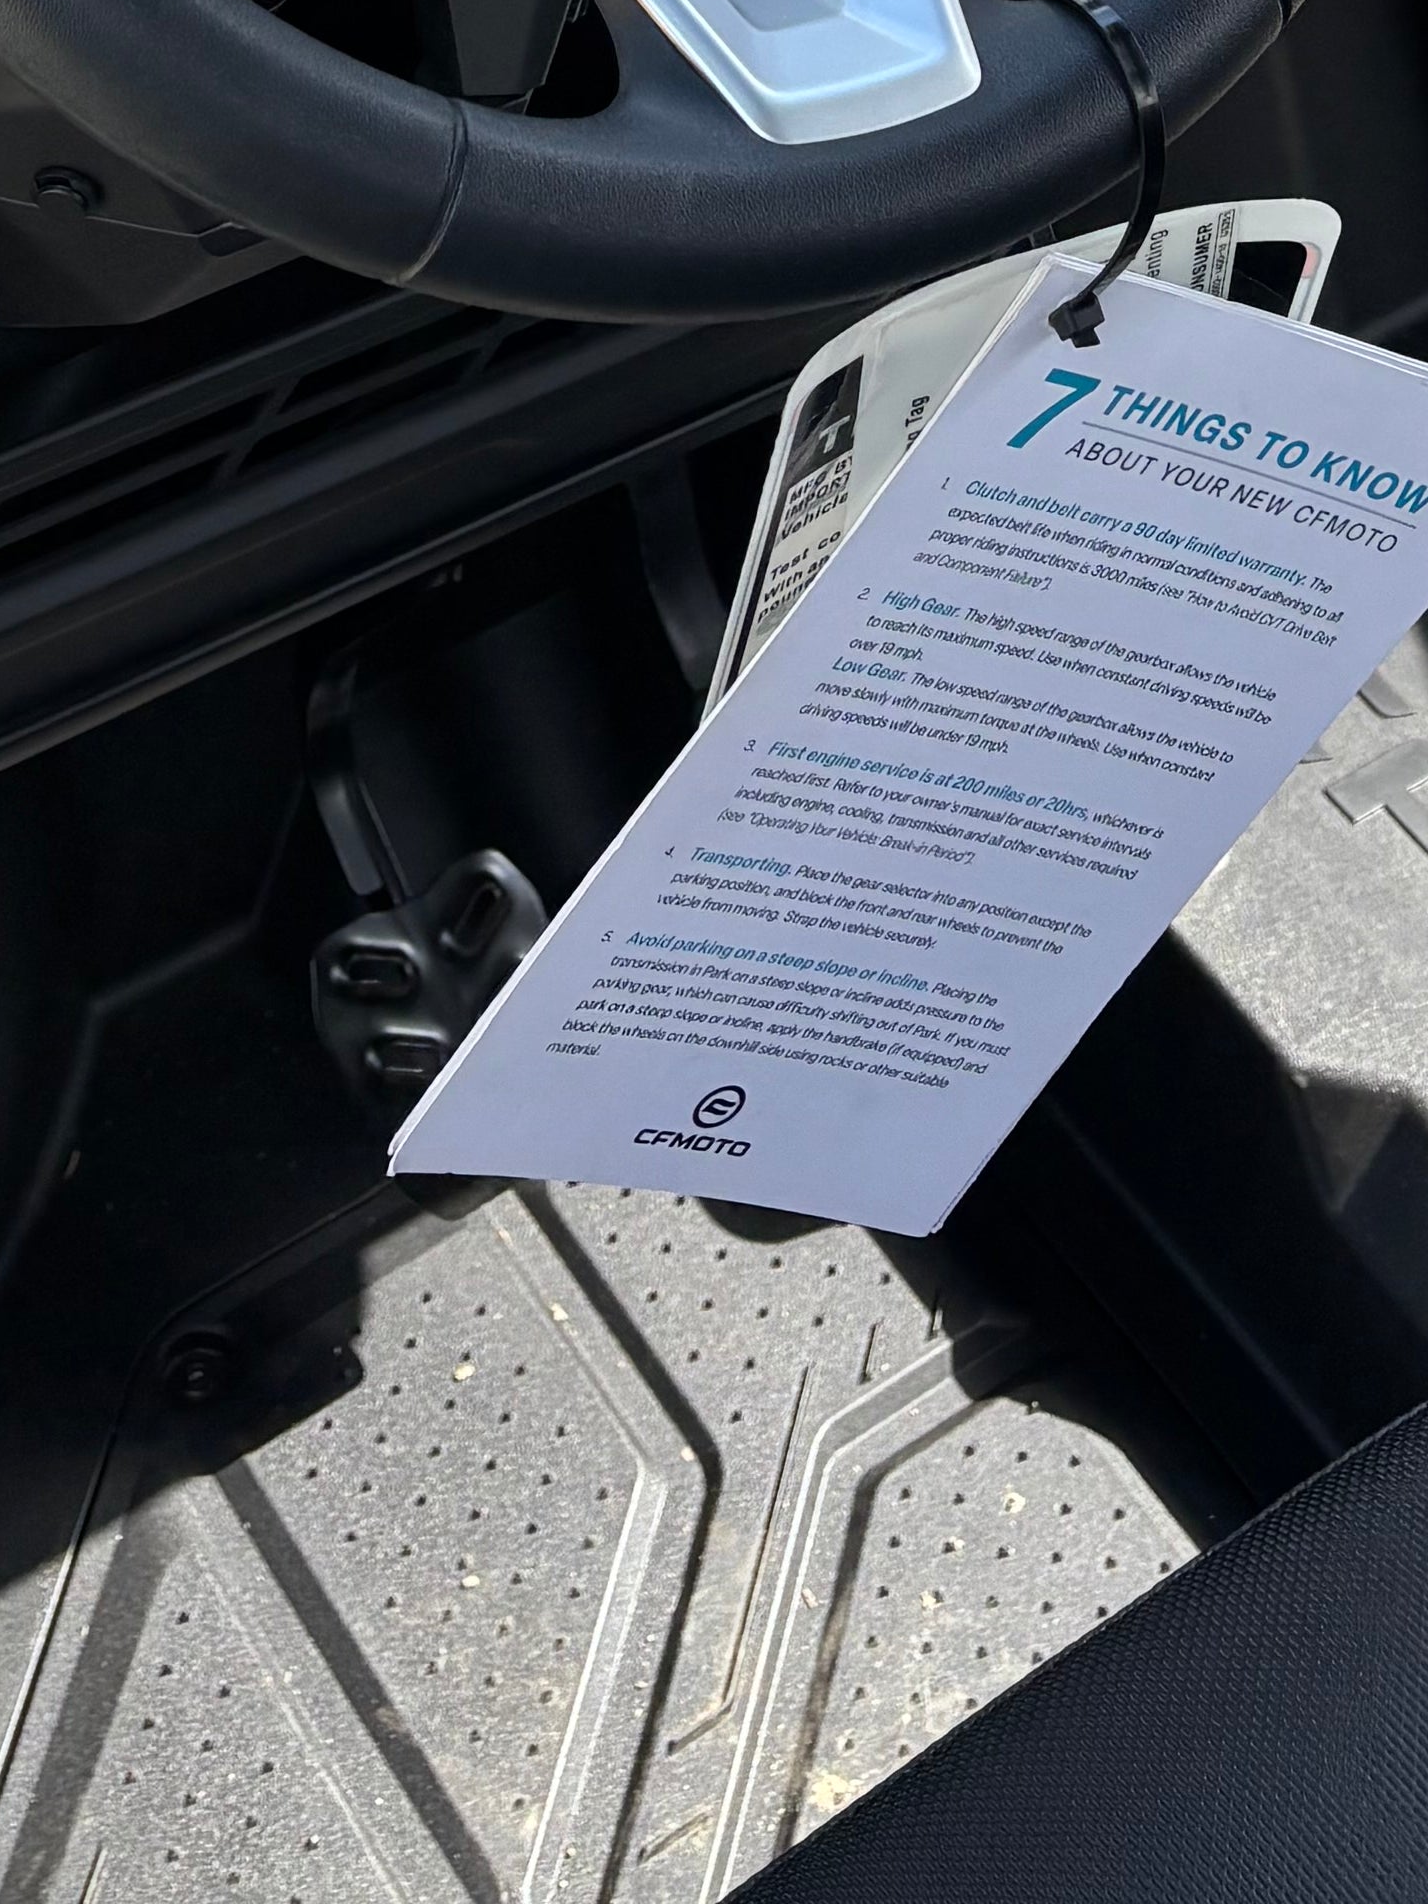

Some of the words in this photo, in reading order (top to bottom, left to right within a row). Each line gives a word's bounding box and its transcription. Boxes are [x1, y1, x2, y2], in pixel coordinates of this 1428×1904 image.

[904, 394, 931, 428] Tag
[1006, 368, 1101, 449] 7
[1103, 385, 1252, 451] THINGS
[1256, 430, 1310, 469] TO
[1064, 438, 1159, 475] ABOUT
[1160, 461, 1230, 498] YOUR
[1229, 483, 1294, 516] NEW
[1293, 505, 1398, 553] CFMOTO
[965, 480, 1018, 504] Clutch
[1016, 495, 1052, 511] and
[1046, 499, 1081, 520] belt
[1079, 511, 1123, 532] carry
[1120, 521, 1134, 533] a
[1133, 522, 1159, 539] 90
[1155, 528, 1187, 550] day
[1184, 536, 1241, 563] limited
[771, 546, 810, 581] Test
[881, 590, 921, 611] High
[921, 597, 961, 618] Gear.
[831, 656, 868, 674] Low
[867, 662, 908, 682] Gear.
[767, 741, 807, 760] First
[806, 750, 861, 769] engine
[860, 760, 919, 780] service
[918, 767, 935, 784] is
[933, 773, 955, 788] at
[951, 775, 986, 794] 200
[982, 784, 1026, 803] miles
[1025, 795, 1046, 808] or
[1042, 796, 1089, 822] 20hrs,
[691, 847, 791, 877] Transporting.
[625, 931, 676, 949] Avoid
[669, 939, 735, 960] parking
[733, 948, 756, 961] on
[755, 951, 768, 963] a
[767, 952, 815, 971] steep
[814, 959, 858, 978] slope
[857, 968, 878, 981] or
[877, 969, 929, 992] incline.
[634, 1128, 751, 1158] CFMOTO
